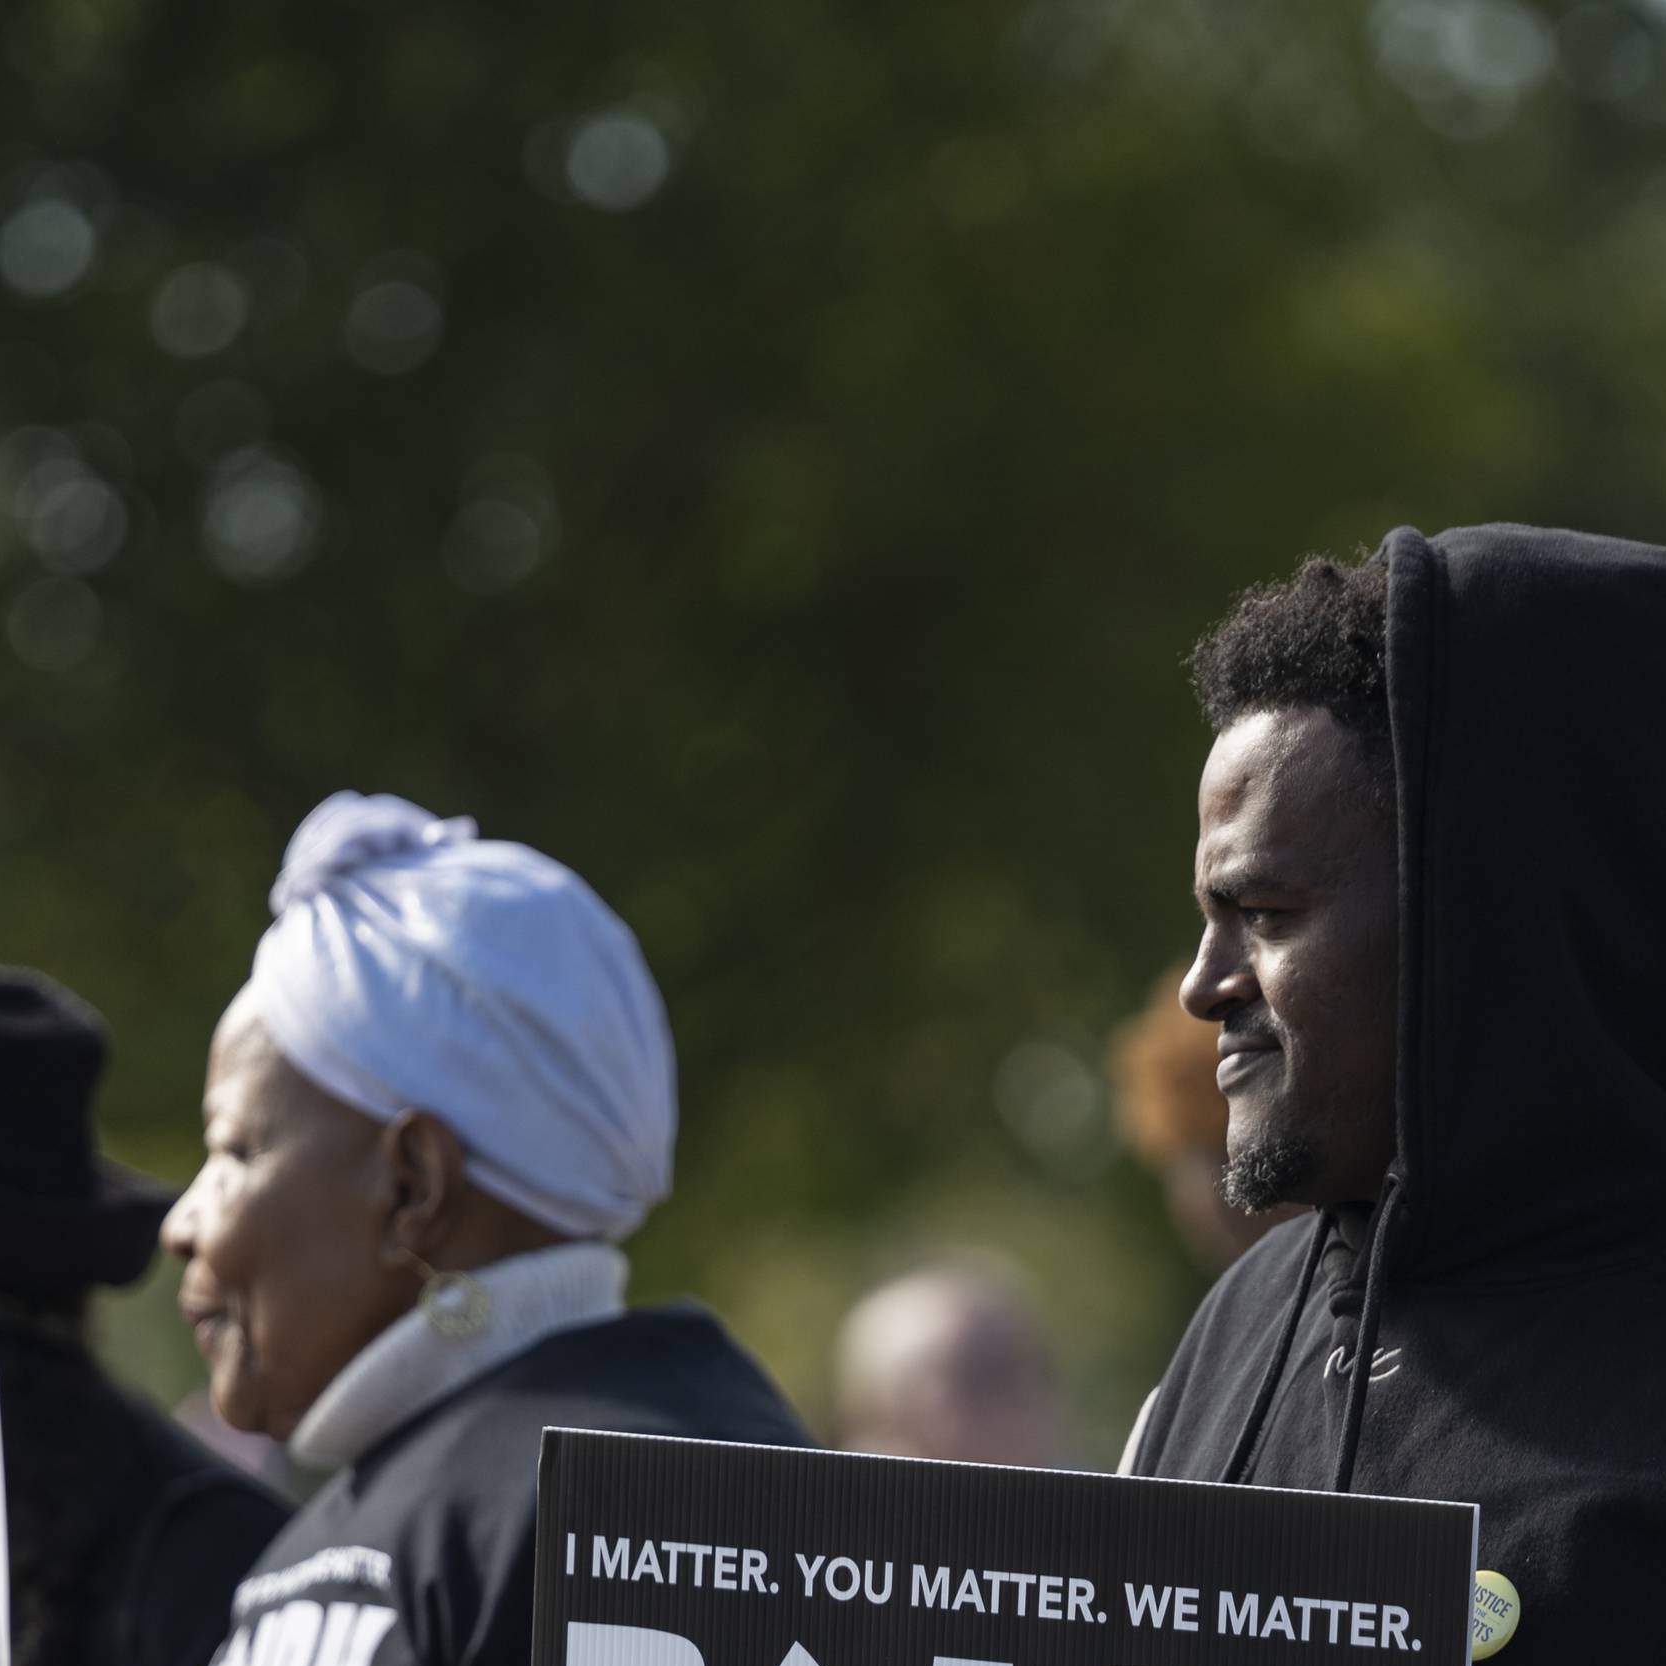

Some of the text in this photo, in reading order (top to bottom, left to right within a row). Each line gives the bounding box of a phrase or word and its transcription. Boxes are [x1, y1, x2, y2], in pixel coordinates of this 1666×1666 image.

[566, 1533, 1422, 1651] I MATTER. YOU MATTER. WE MATTER.
